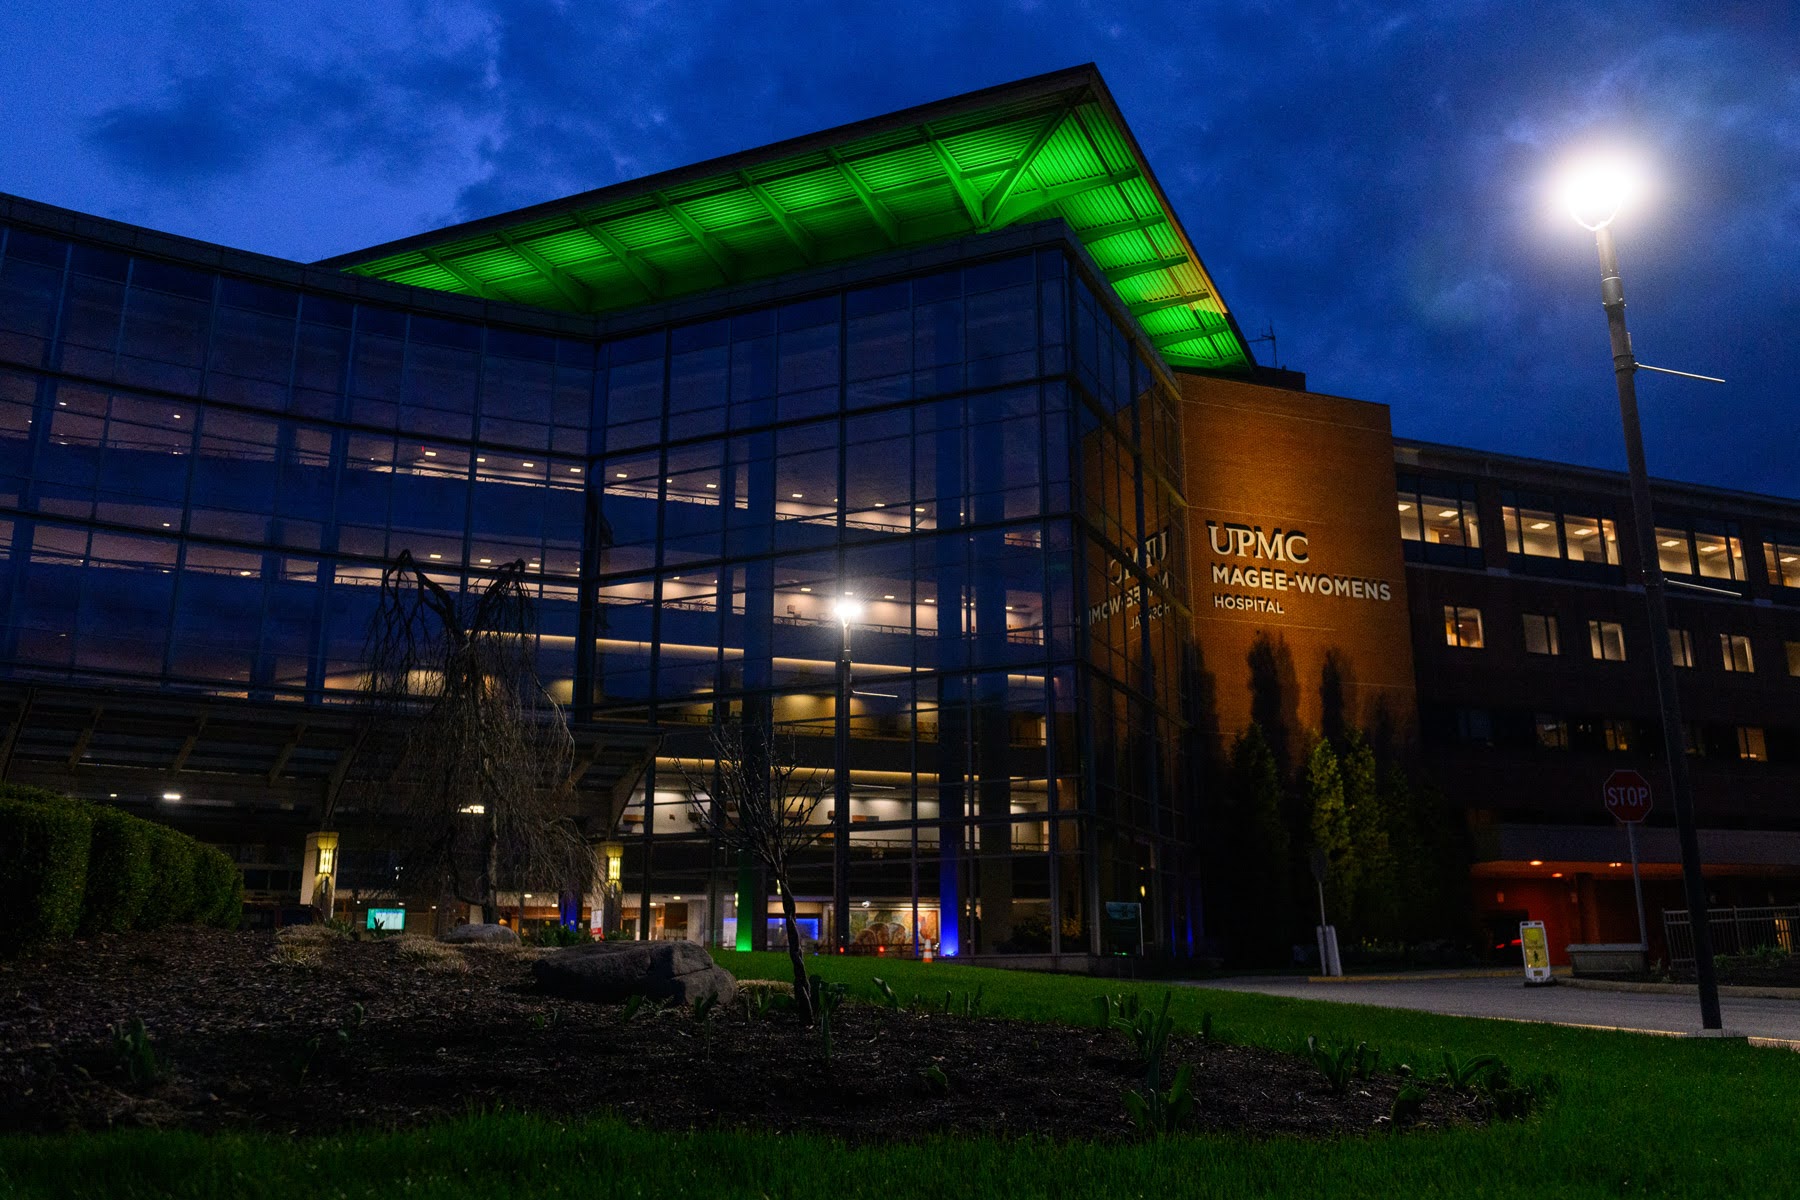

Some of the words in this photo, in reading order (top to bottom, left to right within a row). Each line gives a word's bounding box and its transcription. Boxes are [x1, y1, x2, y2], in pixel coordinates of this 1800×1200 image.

[1208, 525, 1309, 564] UPMC
[1212, 565, 1391, 601] MAGEE-WOMENS
[1214, 595, 1285, 614] HOSPITAL
[1607, 786, 1649, 807] STOP
